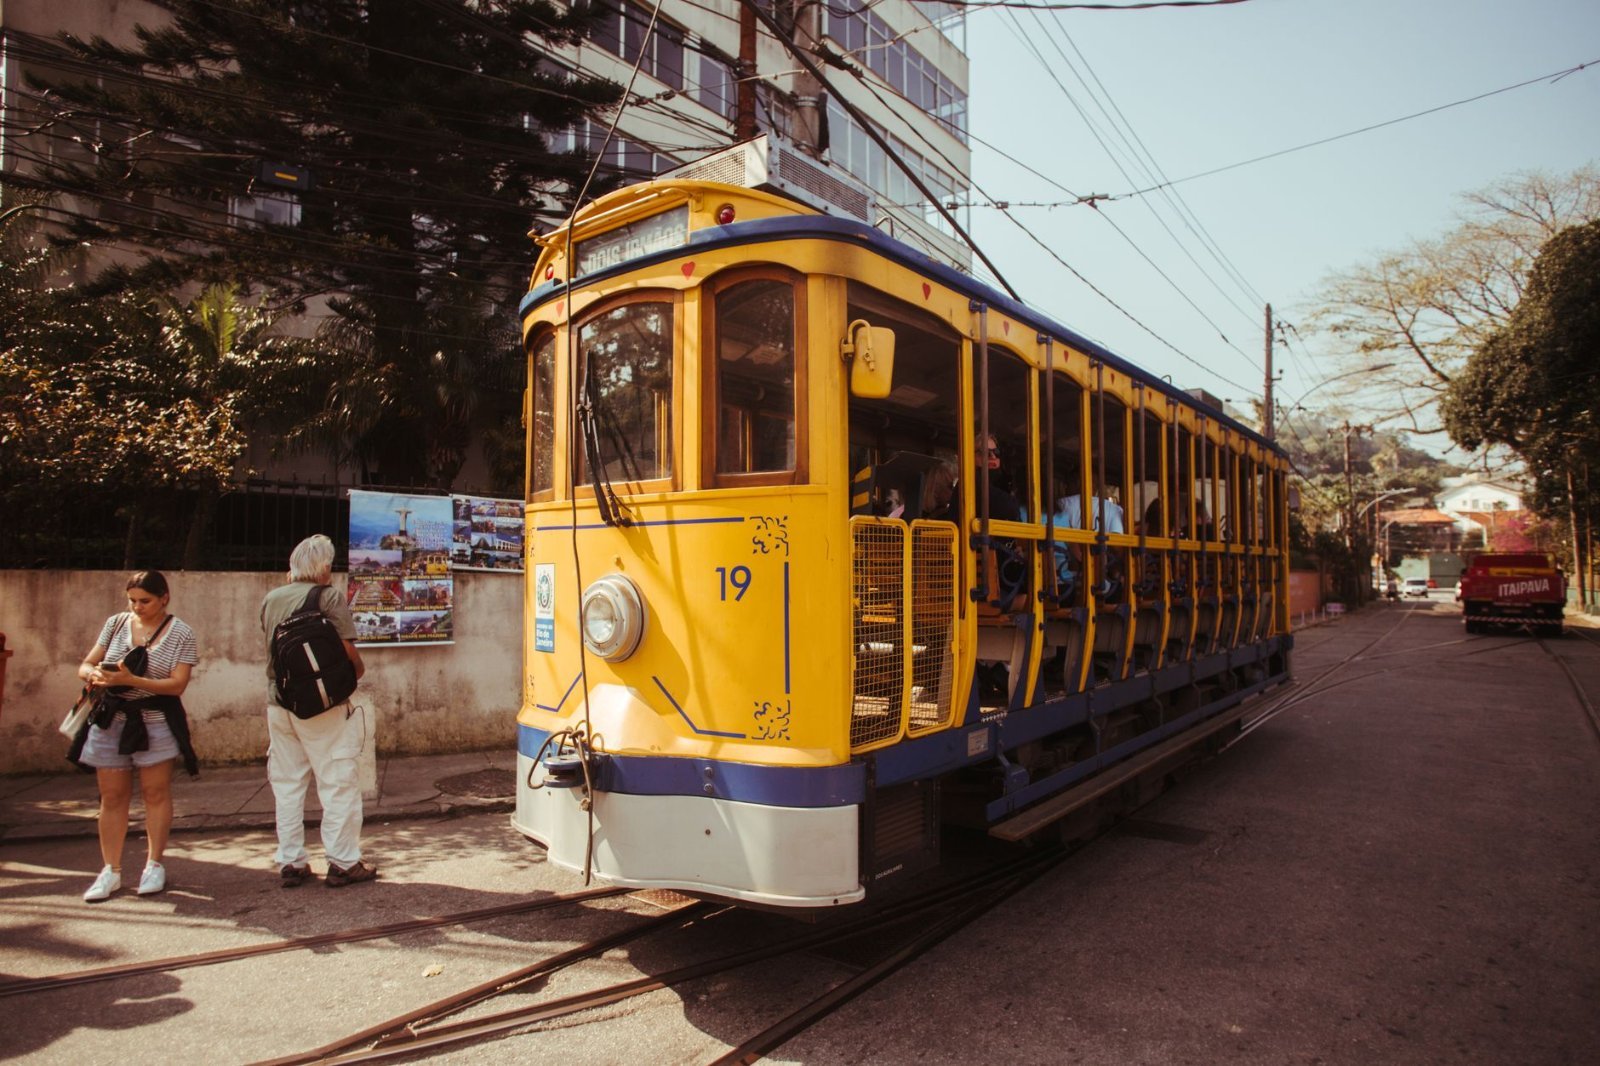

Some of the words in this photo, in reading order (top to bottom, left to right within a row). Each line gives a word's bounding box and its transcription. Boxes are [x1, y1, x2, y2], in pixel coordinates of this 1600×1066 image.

[588, 244, 621, 273] DOIS
[715, 565, 752, 602] 19
[1498, 578, 1549, 597] ITAIPAVA
